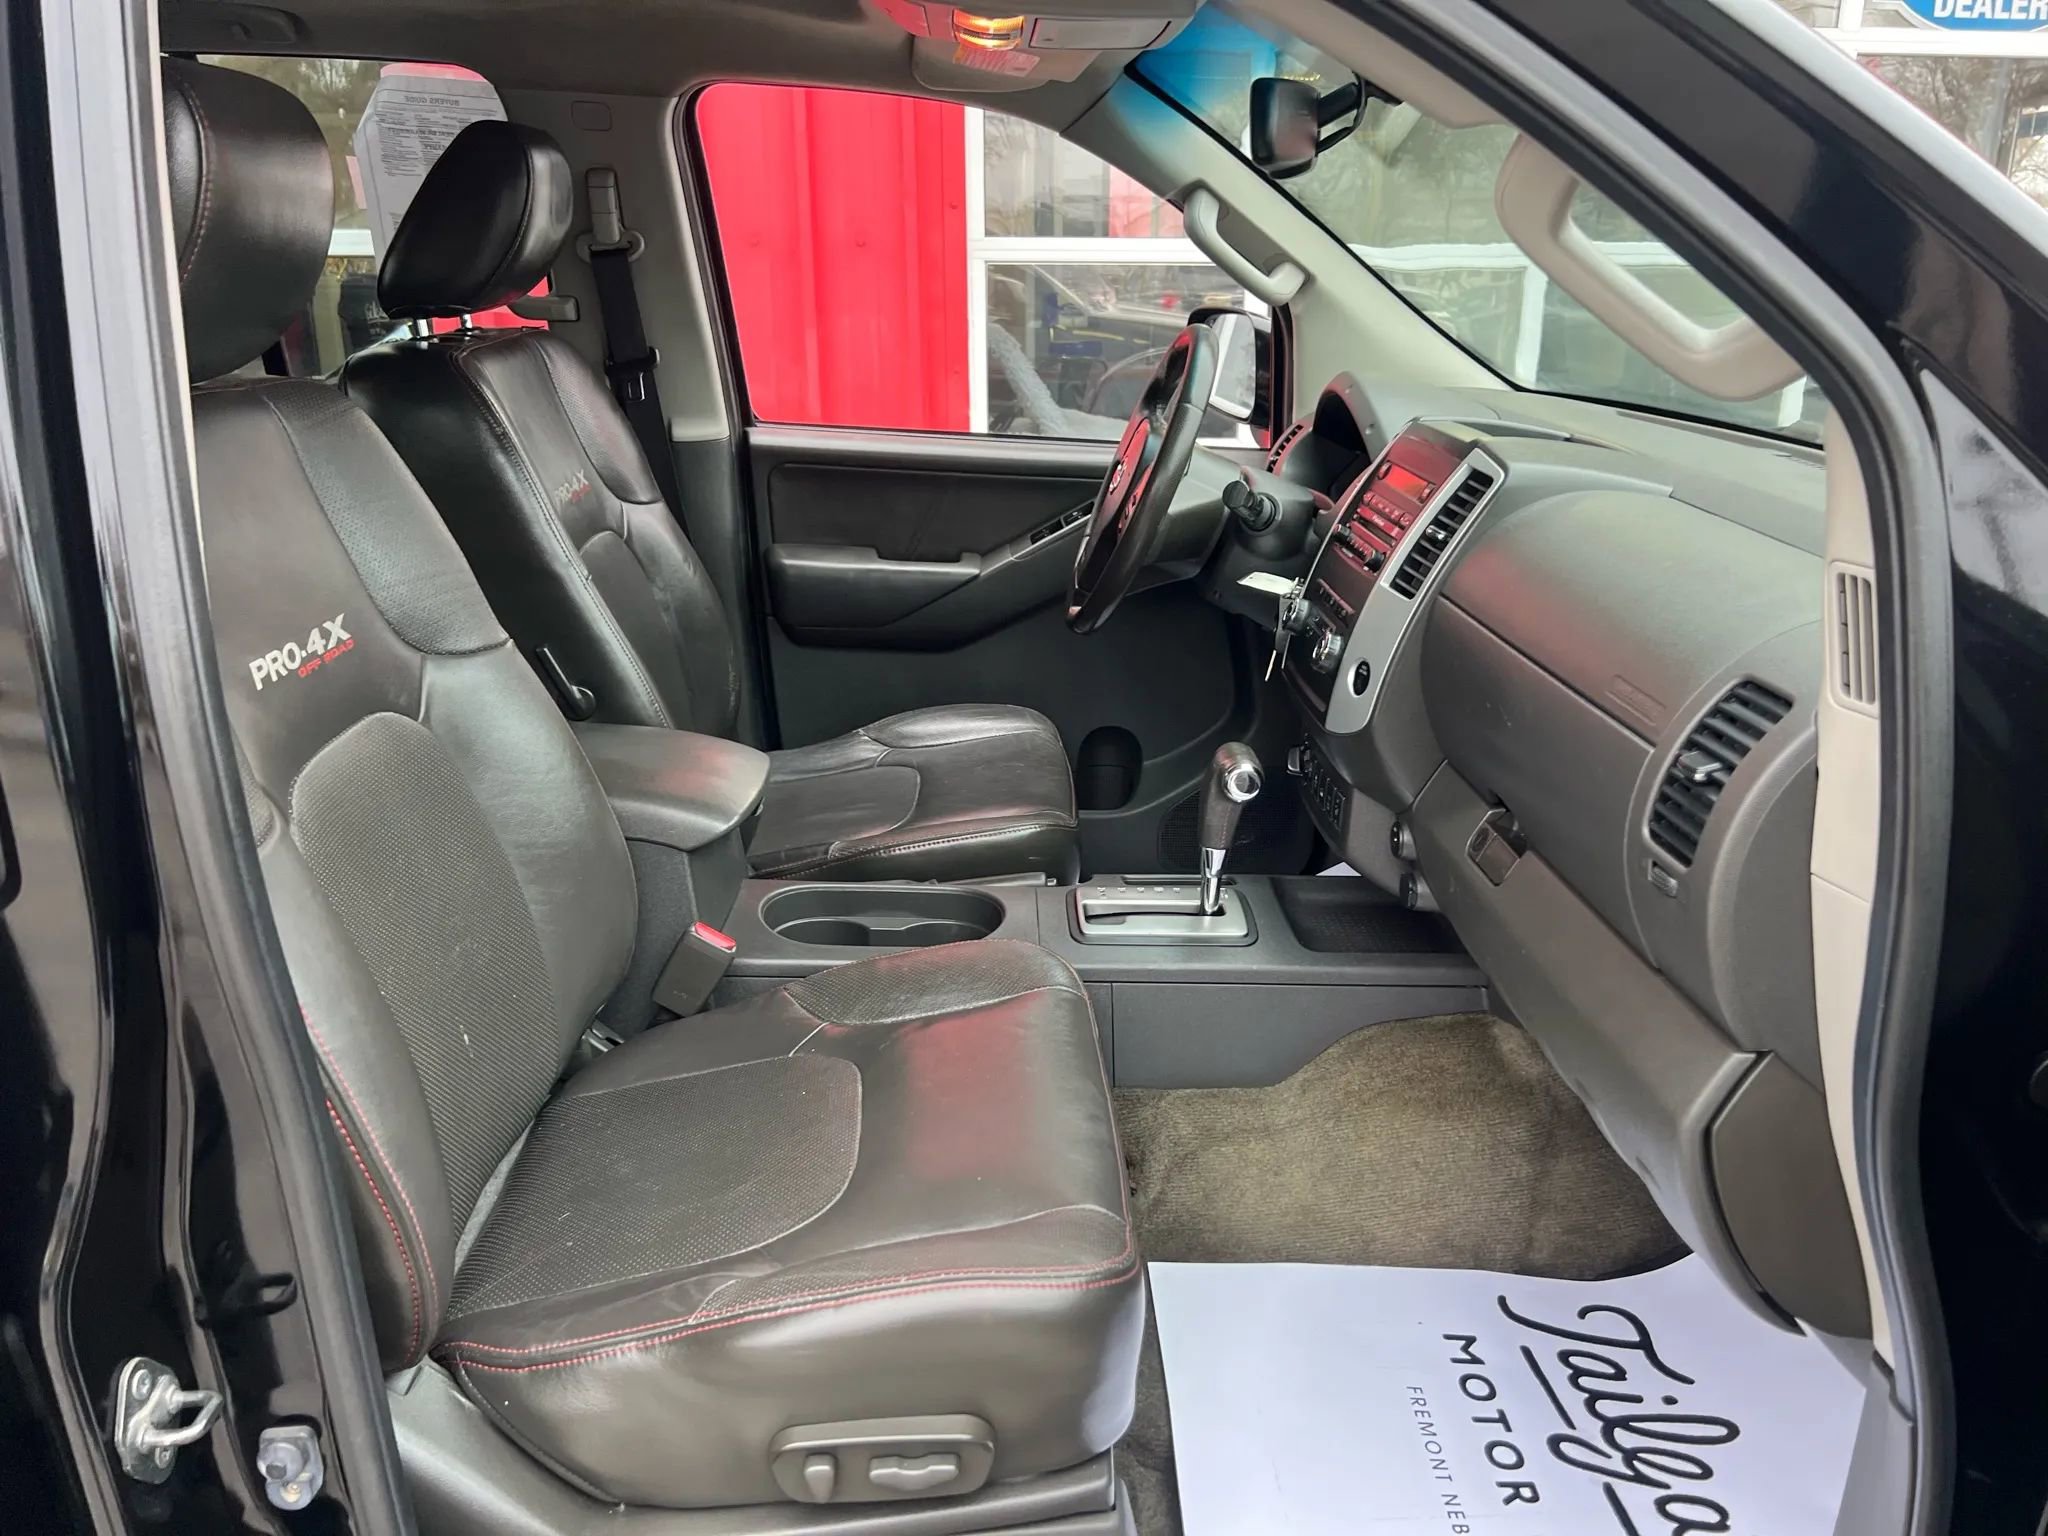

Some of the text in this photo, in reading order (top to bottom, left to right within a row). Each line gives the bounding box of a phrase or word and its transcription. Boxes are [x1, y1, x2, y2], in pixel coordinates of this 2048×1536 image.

[1406, 1385, 1470, 1535] FREMONT NEB
[1442, 1334, 1540, 1506] MOTOR
